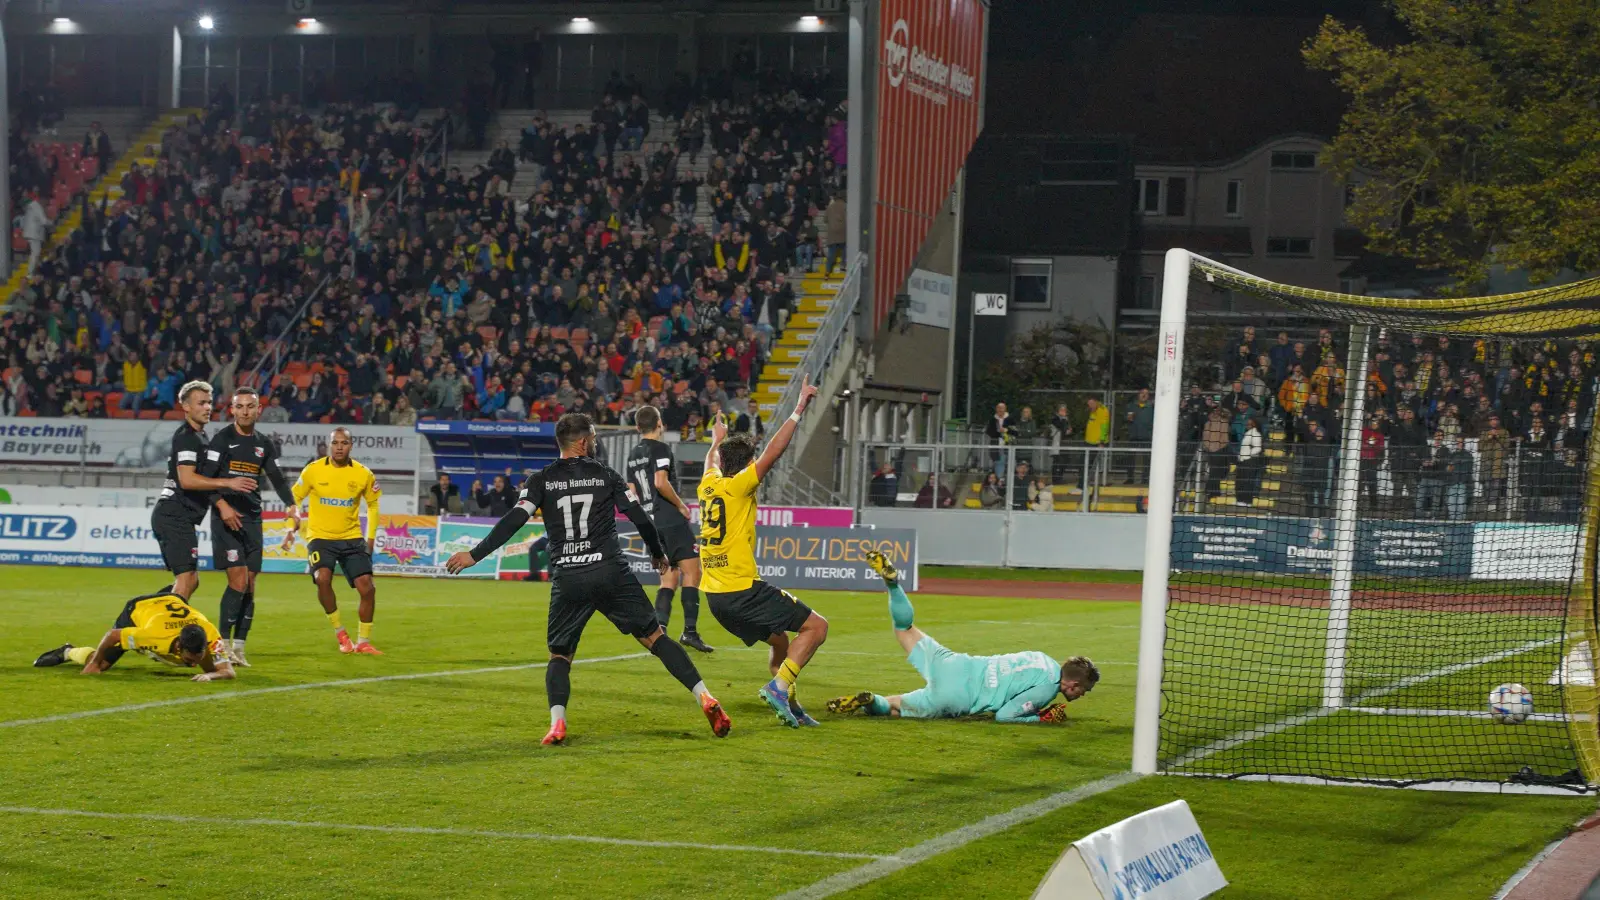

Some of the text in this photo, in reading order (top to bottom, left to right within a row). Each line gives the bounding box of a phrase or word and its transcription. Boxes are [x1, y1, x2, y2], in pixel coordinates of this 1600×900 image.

[986, 295, 1004, 309] WC
[570, 478, 605, 488] Hankofen
[557, 494, 594, 540] 17
[0, 516, 69, 538] LITZ
[376, 536, 428, 550] STURM
[562, 541, 591, 555] HOFER
[763, 536, 910, 563] HOLZ DESIGN
[757, 566, 907, 580] UDIO INTERIOR DEN
